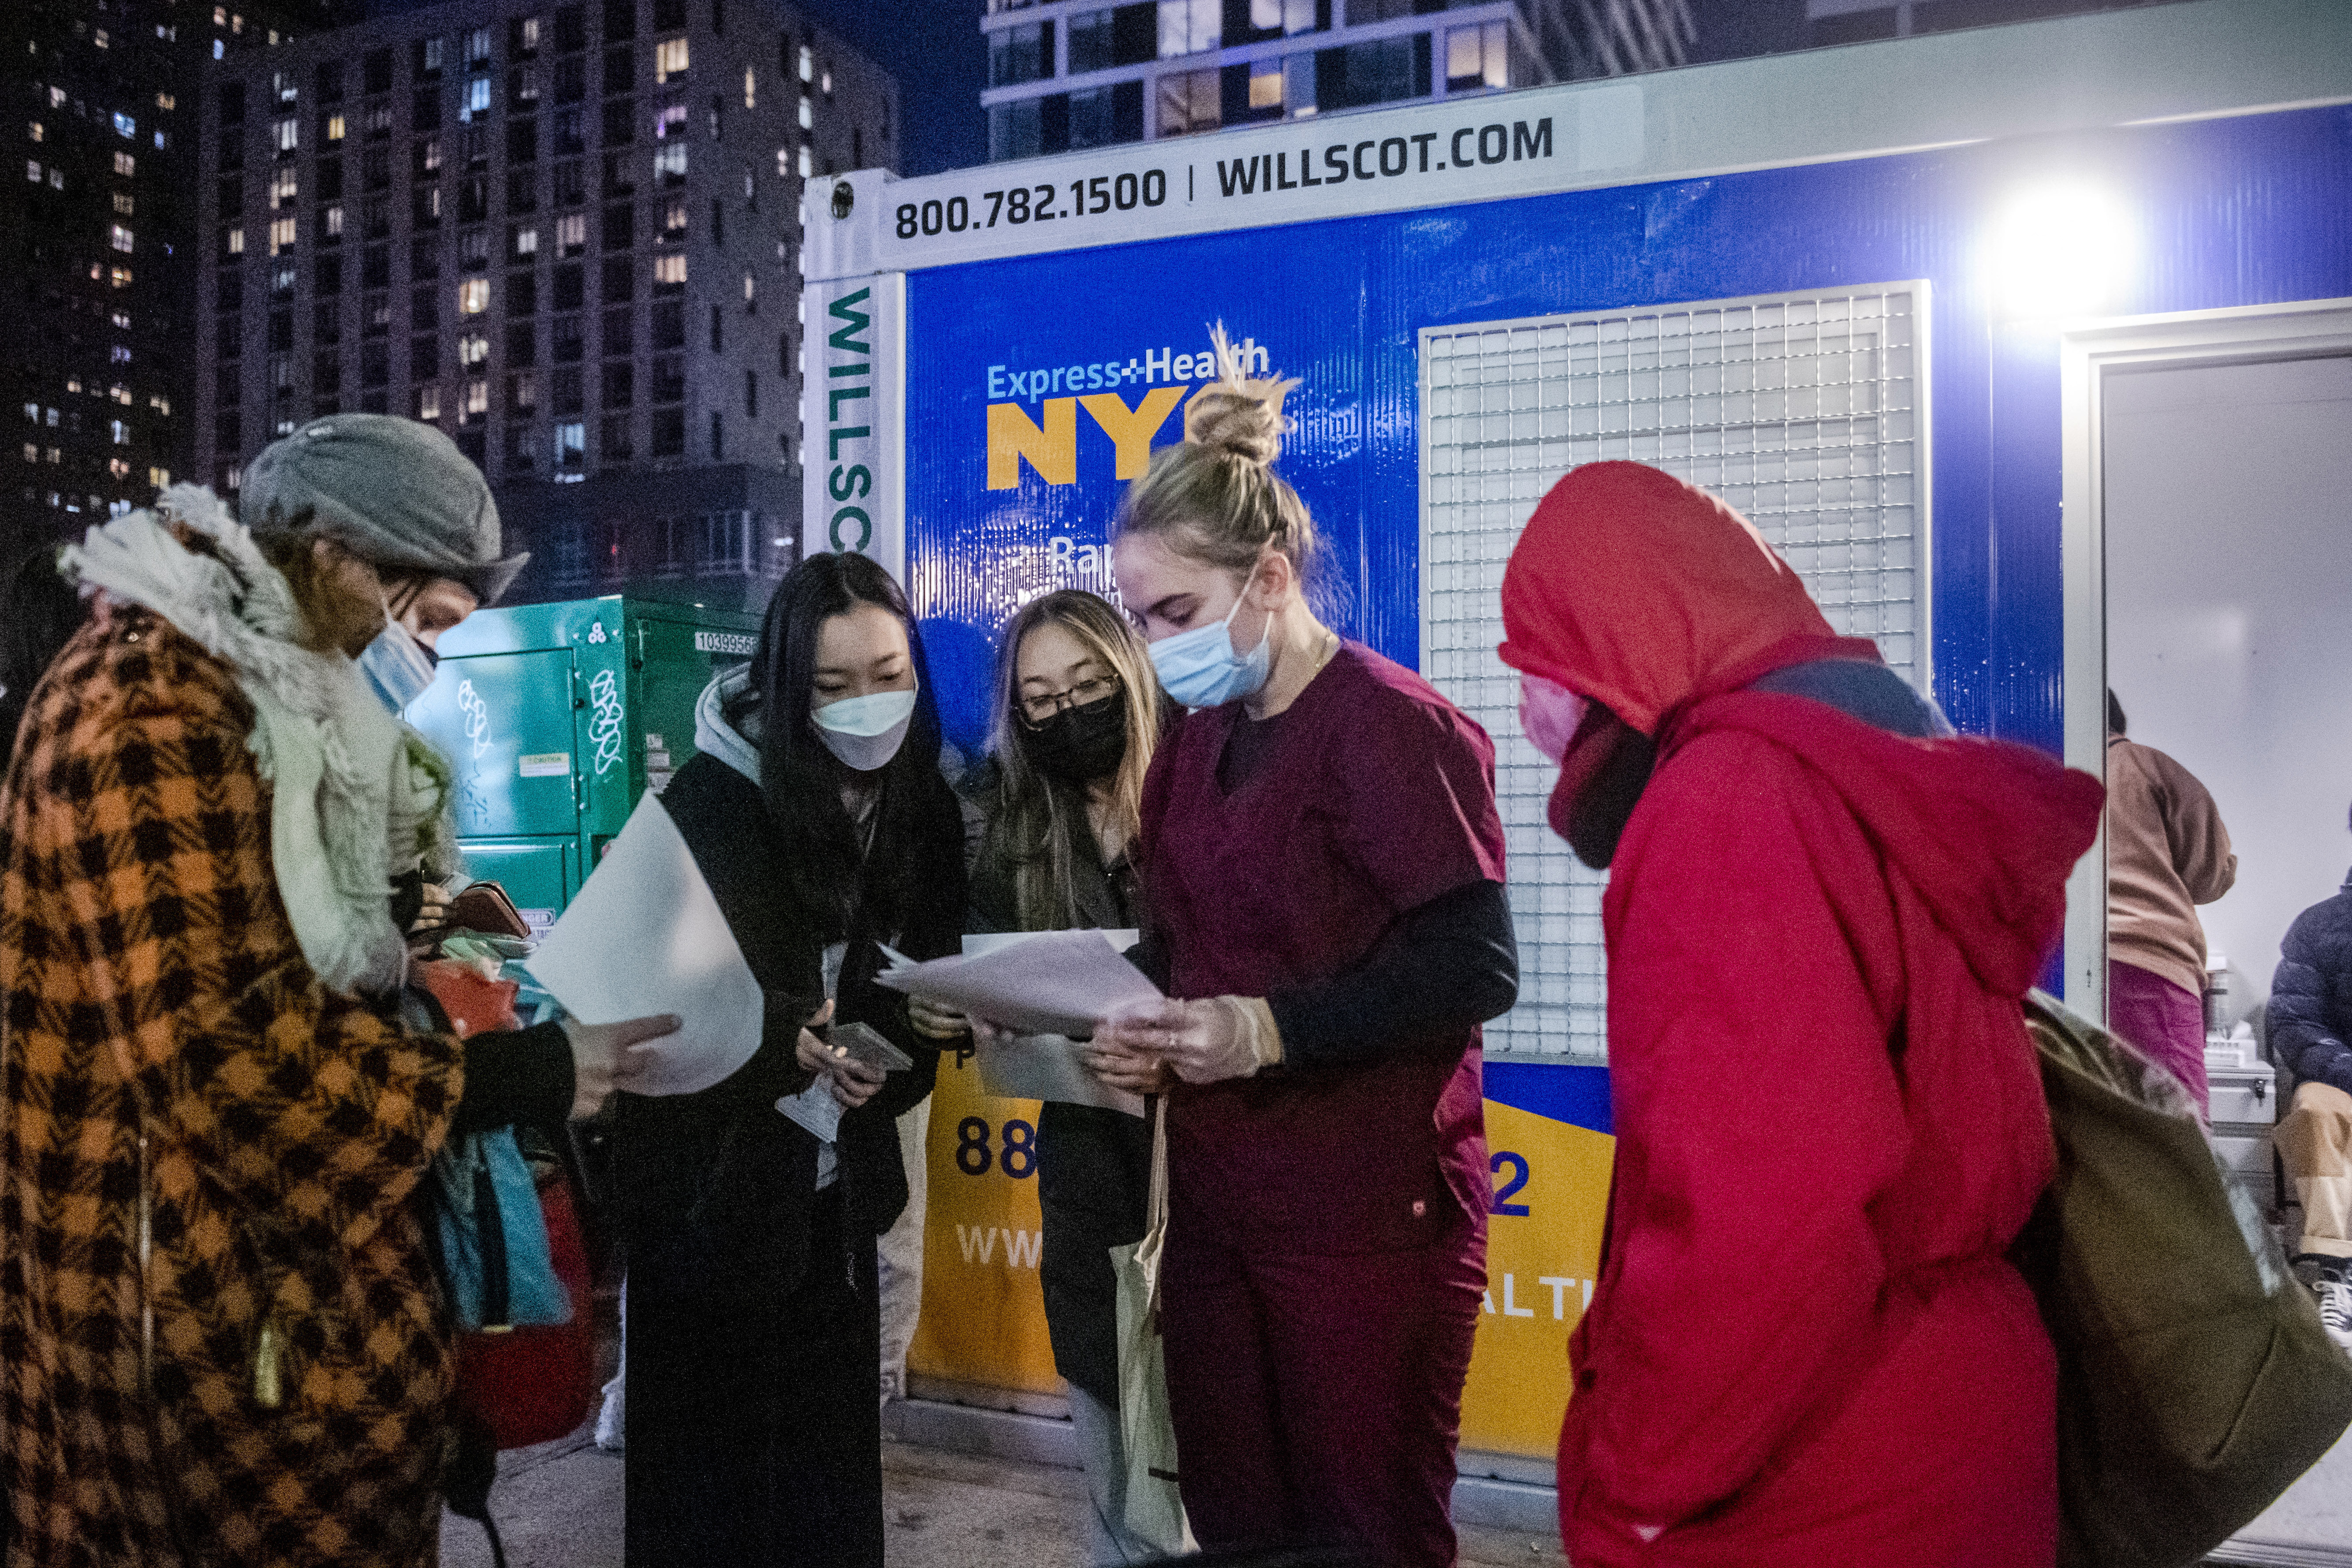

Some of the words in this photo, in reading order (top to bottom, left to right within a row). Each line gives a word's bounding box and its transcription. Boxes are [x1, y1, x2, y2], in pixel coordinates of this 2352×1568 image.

[896, 169, 1166, 239] 800.782.1500
[1217, 117, 1554, 197] WILLSCOT.COM
[956, 1116, 1037, 1180] 88
